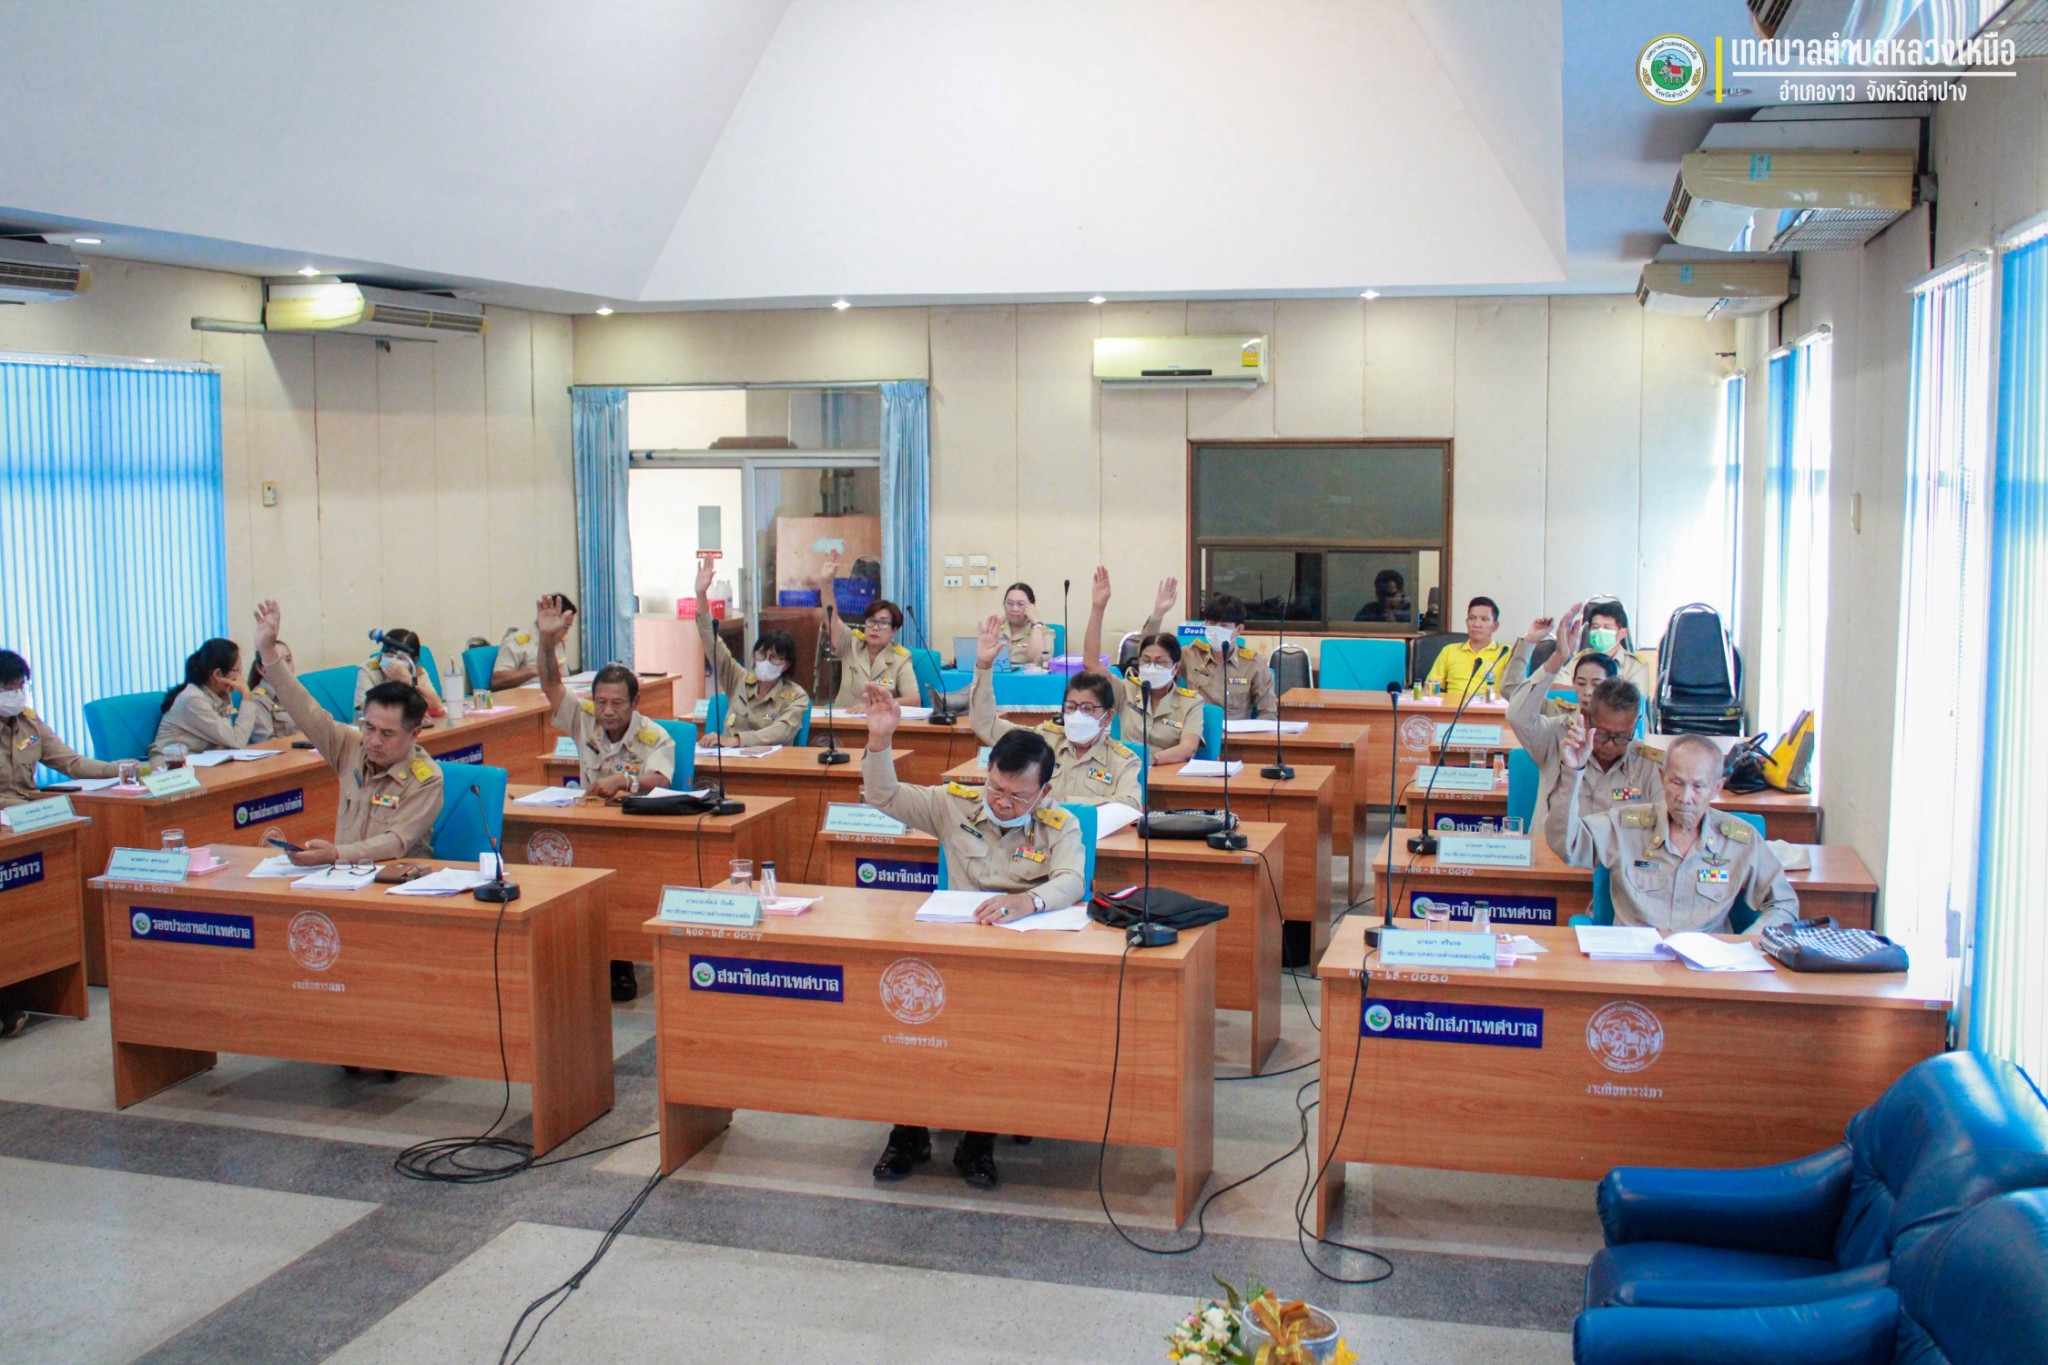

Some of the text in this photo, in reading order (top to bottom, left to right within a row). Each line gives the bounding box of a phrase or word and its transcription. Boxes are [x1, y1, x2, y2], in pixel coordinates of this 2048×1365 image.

[1184, 627, 1206, 635] Doub
[717, 967, 840, 992] สมาชิกสภาเทศบาล
[1393, 1011, 1538, 1038] สมาชิกสภาเทศบาล
